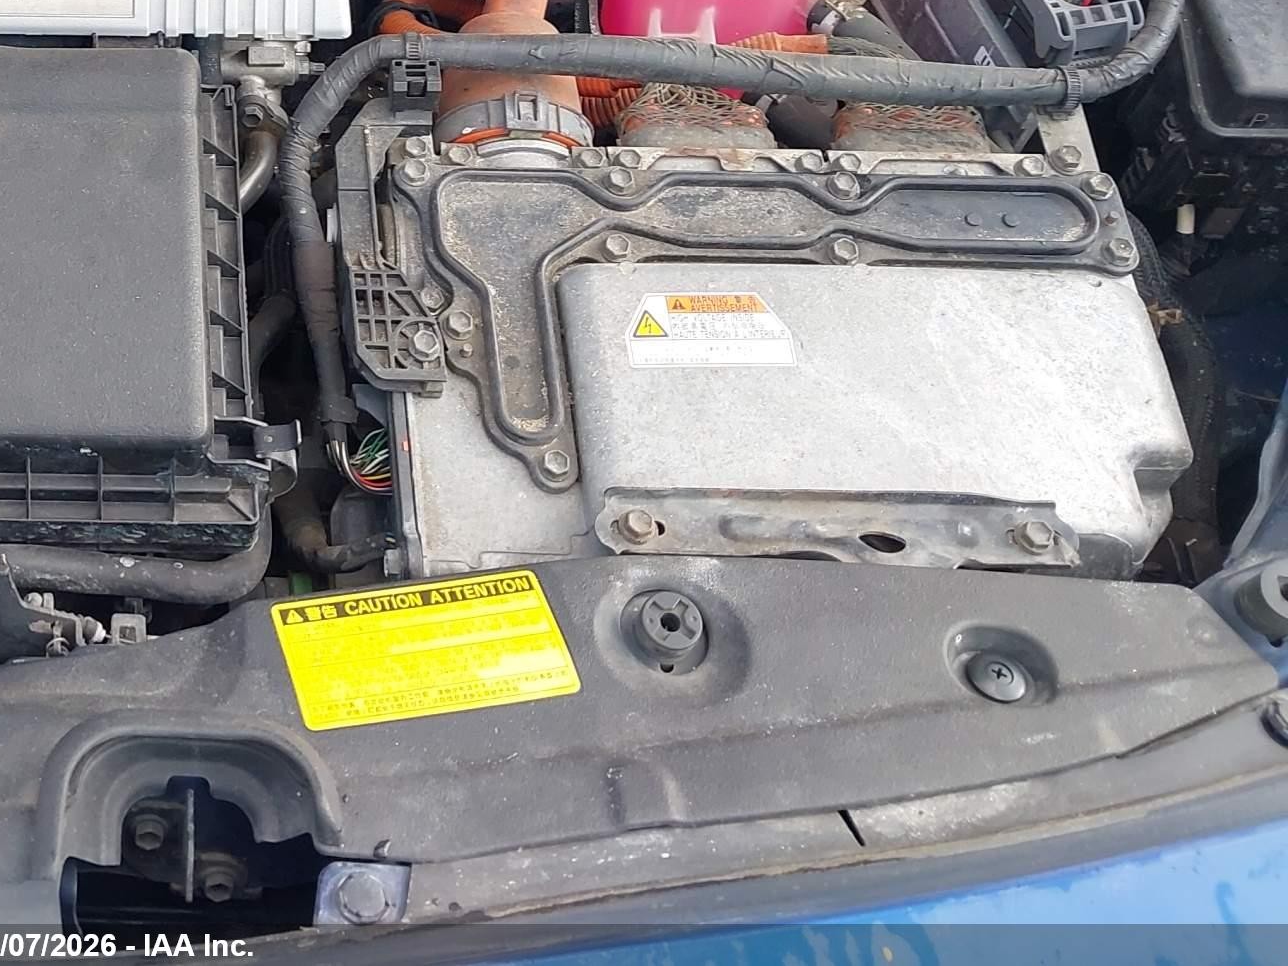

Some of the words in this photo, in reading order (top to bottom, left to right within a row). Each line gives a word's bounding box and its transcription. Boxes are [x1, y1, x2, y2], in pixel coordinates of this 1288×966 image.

[689, 295, 728, 304] WARNING
[690, 303, 758, 312] AVERTISSEMENT
[344, 591, 423, 616] CAUTION
[429, 576, 531, 605] ATTENTION
